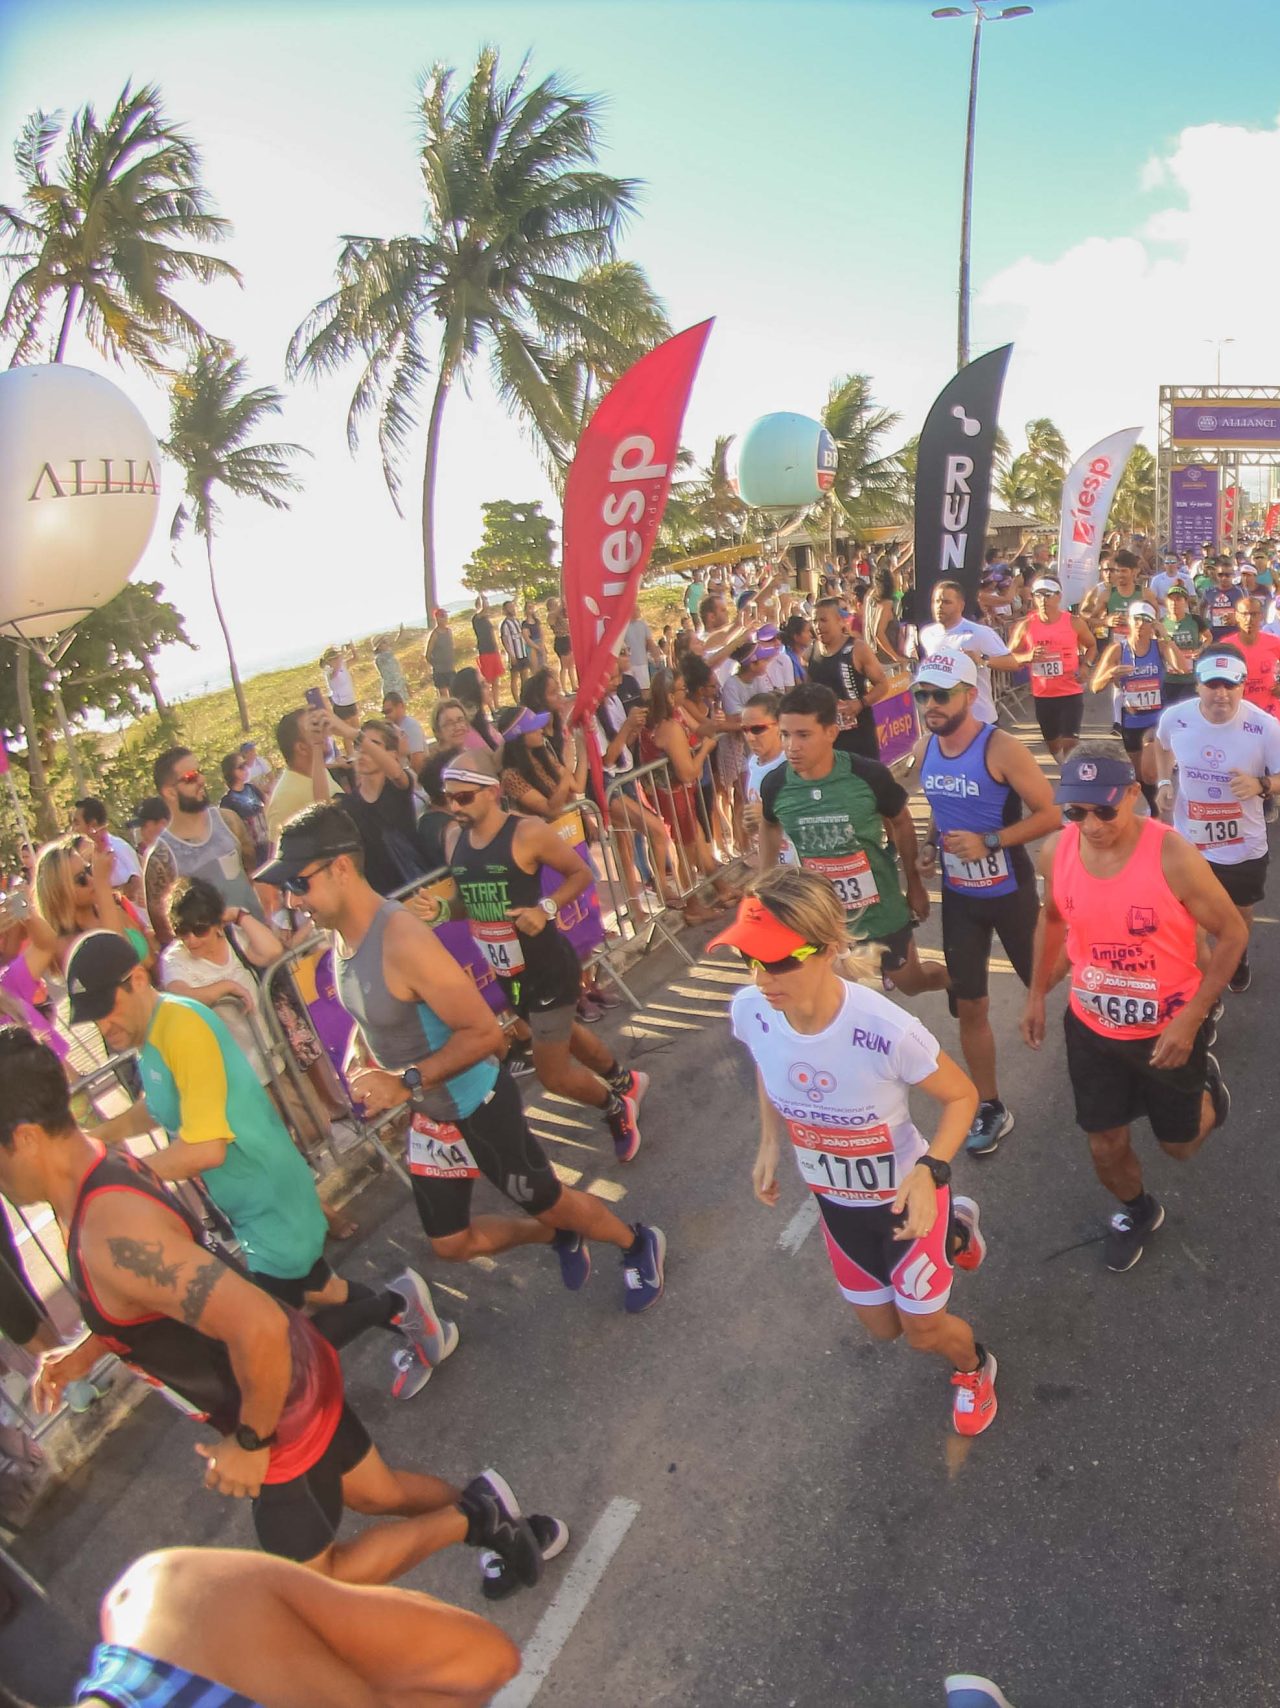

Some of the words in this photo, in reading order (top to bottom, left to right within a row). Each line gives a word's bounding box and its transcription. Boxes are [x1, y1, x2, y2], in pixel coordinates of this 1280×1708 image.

[1221, 418, 1277, 427] ALLIANCE
[1071, 457, 1113, 517] iesp
[940, 455, 974, 571] RUN
[1041, 662, 1059, 675] 128
[1138, 691, 1157, 706] 117
[886, 713, 912, 737] iesp
[1243, 721, 1264, 735] RUN
[925, 773, 980, 799] acorja
[1187, 770, 1210, 780] JOÃO
[1211, 774, 1232, 783] PESS
[1205, 820, 1238, 842] 130
[961, 852, 999, 877] 118
[460, 881, 509, 903] START
[487, 943, 511, 968] 84
[1104, 977, 1127, 987] JOÃO
[1127, 981, 1157, 991] PESSOA
[1091, 995, 1156, 1025] 1688
[852, 1027, 892, 1056] RUN
[810, 1111, 880, 1126] PESSOA
[822, 1137, 849, 1147] JOÃO
[850, 1136, 888, 1147] PESSOA
[818, 1153, 896, 1191] 1707
[828, 1188, 881, 1201] MONICA
